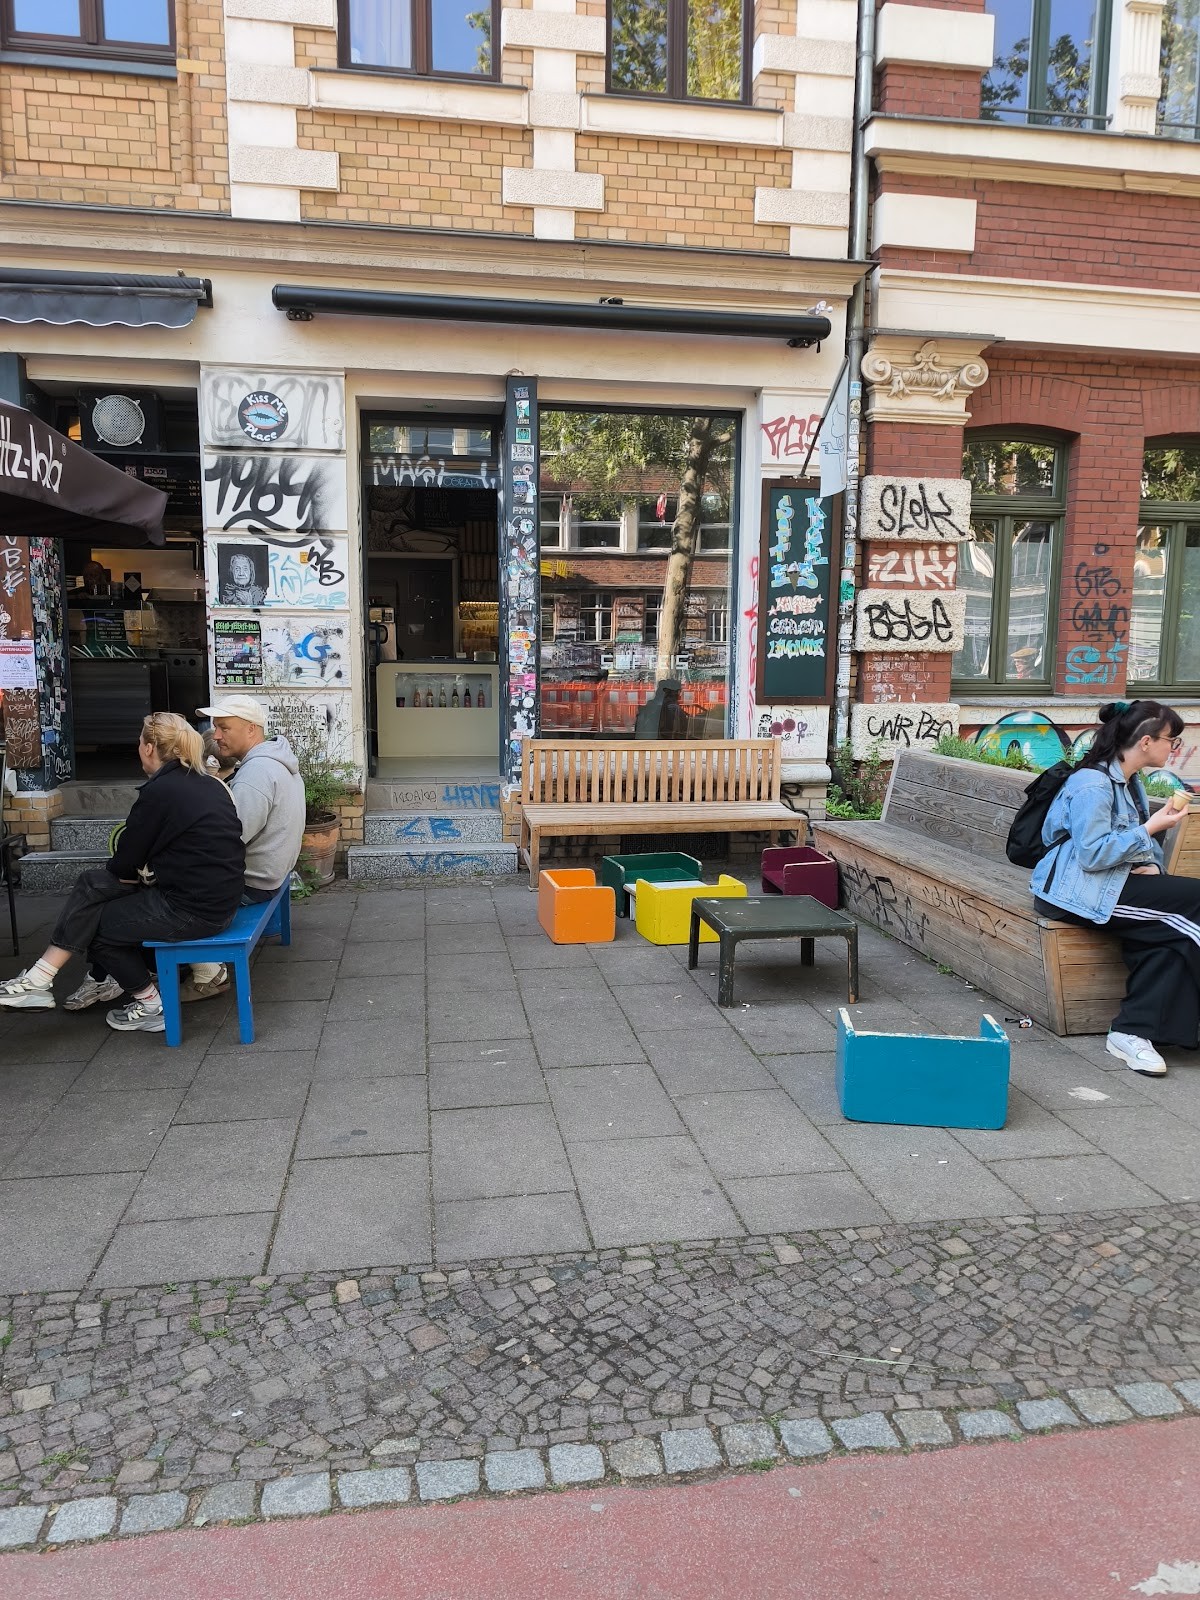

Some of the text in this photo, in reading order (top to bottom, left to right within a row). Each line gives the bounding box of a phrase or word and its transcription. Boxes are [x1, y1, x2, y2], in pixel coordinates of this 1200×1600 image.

[246, 393, 288, 417] Kiss Me
[244, 422, 278, 442] Place
